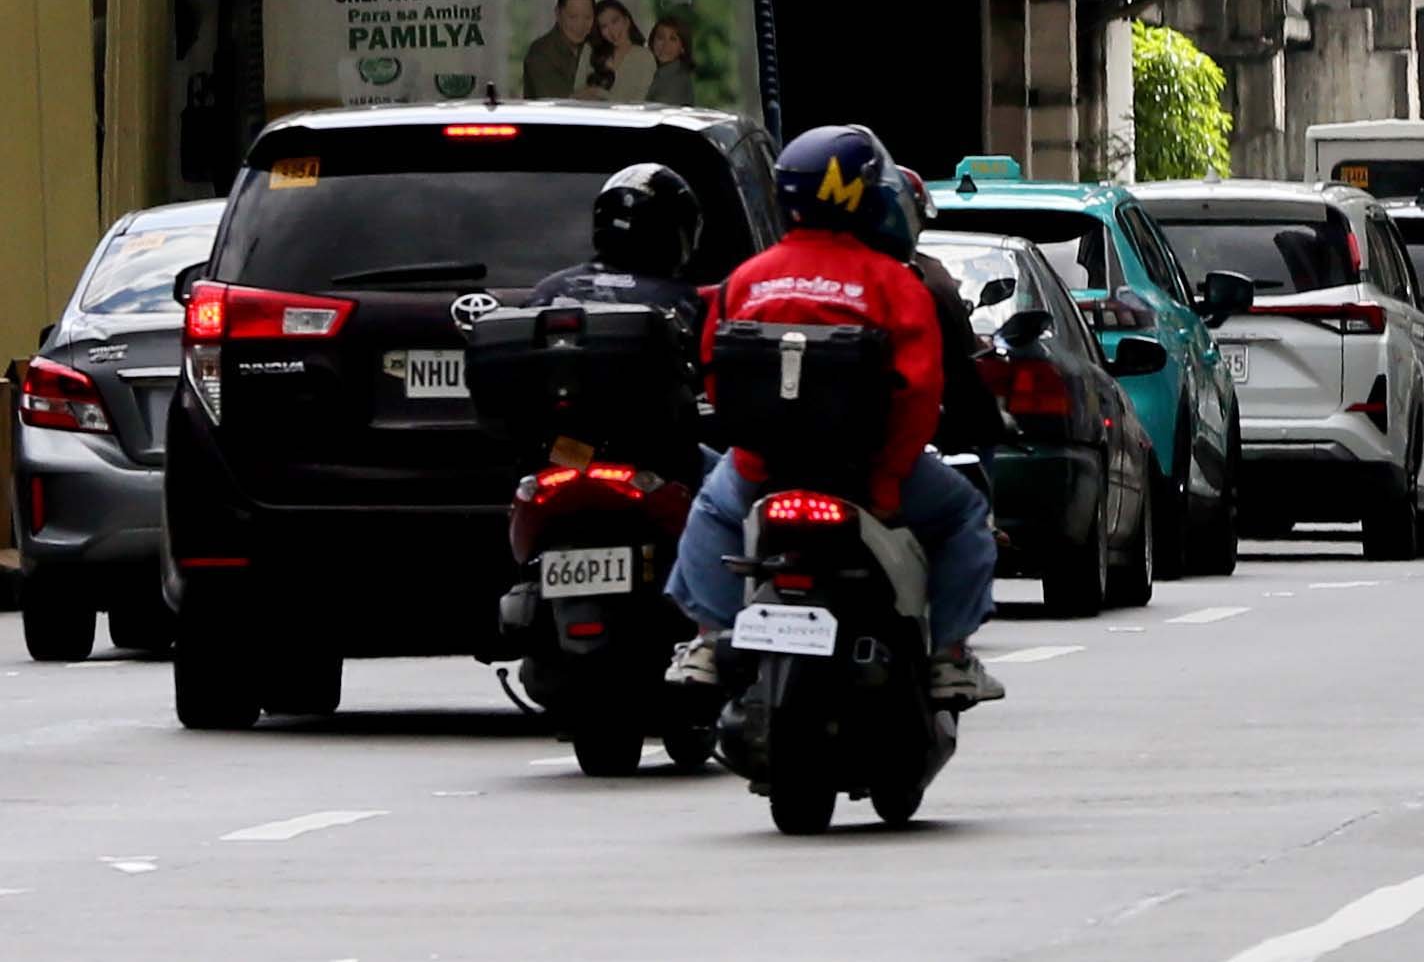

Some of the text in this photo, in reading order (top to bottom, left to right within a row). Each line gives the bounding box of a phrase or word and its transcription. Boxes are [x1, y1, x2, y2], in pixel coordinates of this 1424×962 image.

[349, 4, 482, 23] Para sa Aming
[349, 23, 485, 50] PAMILYA
[410, 359, 460, 388] NHU
